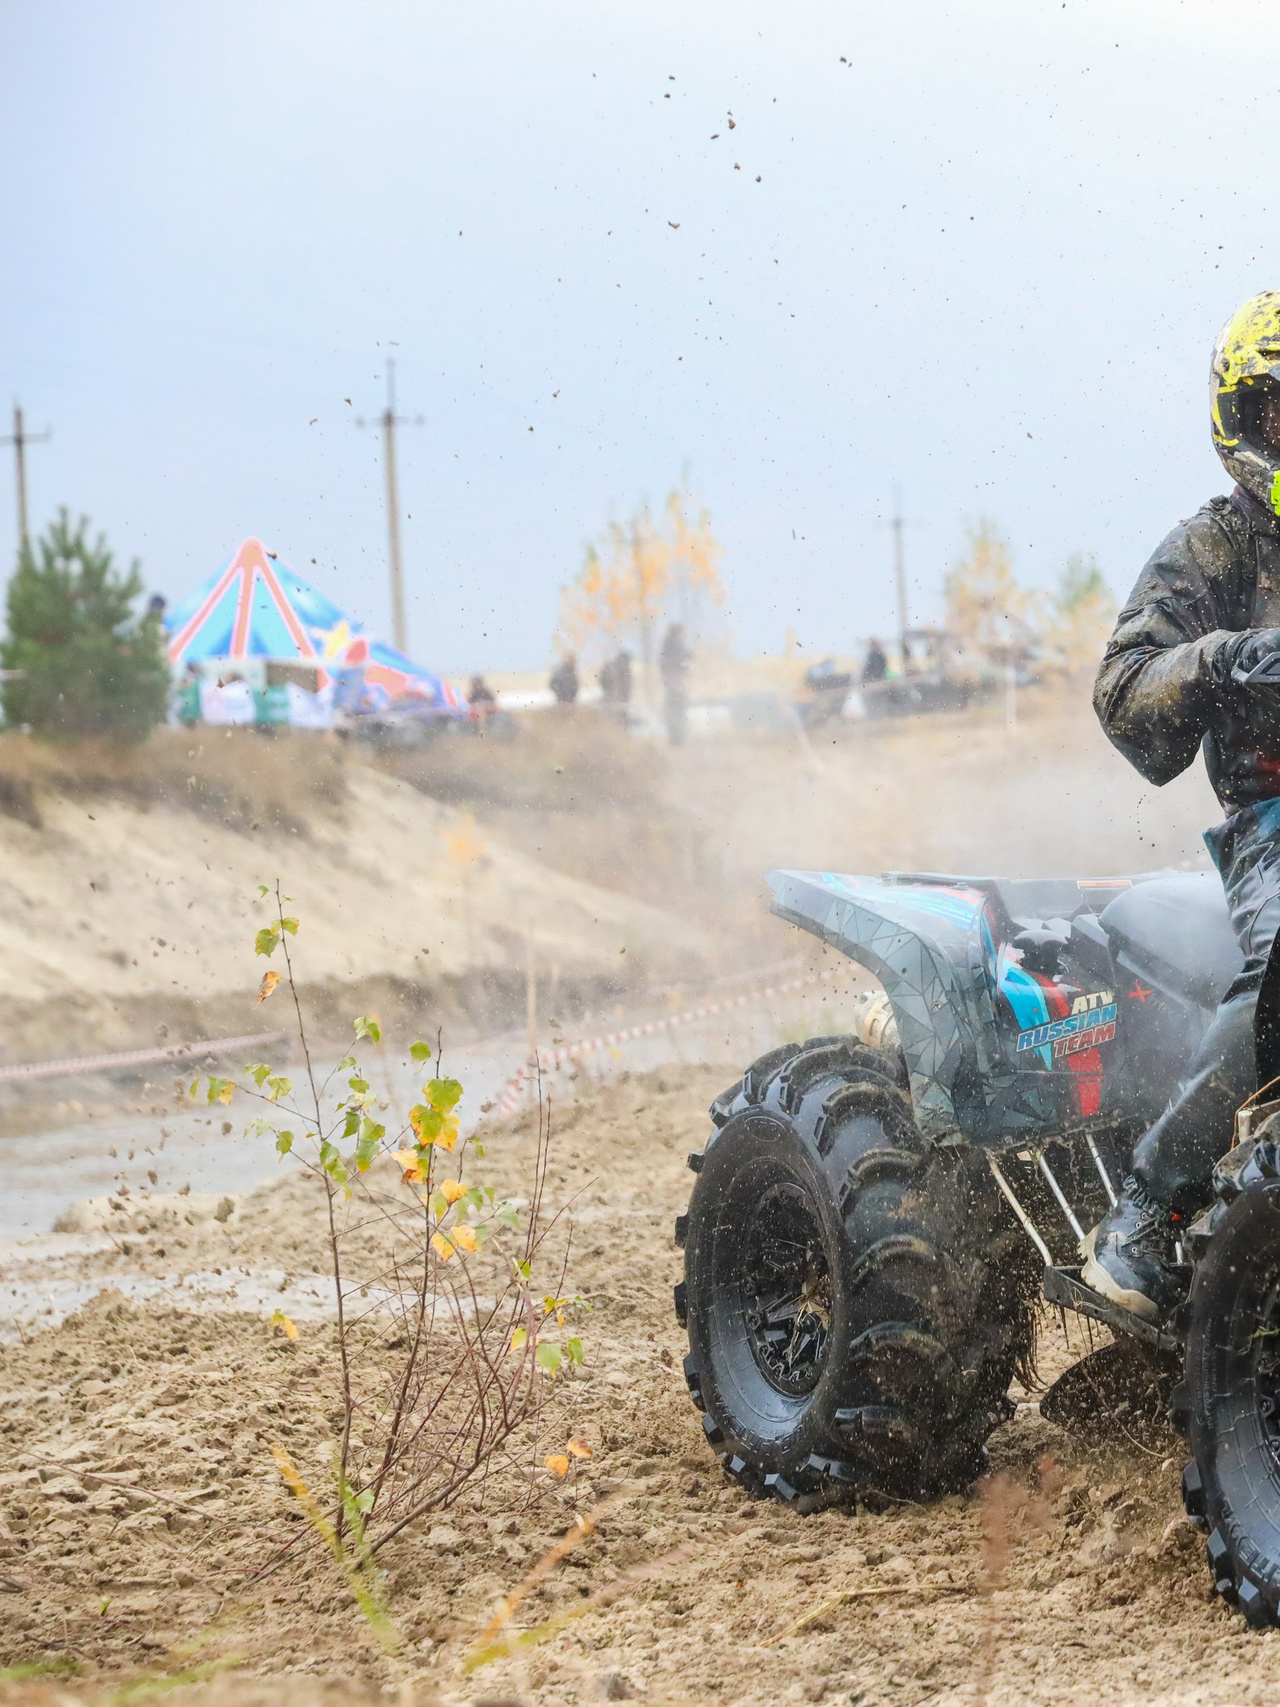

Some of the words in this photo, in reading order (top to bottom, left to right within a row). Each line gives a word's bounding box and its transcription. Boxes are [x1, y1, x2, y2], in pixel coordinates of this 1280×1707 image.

[1071, 991, 1114, 1015] ATV
[1016, 1003, 1117, 1052] RUSSIAN
[1054, 1022, 1116, 1058] TEAM
